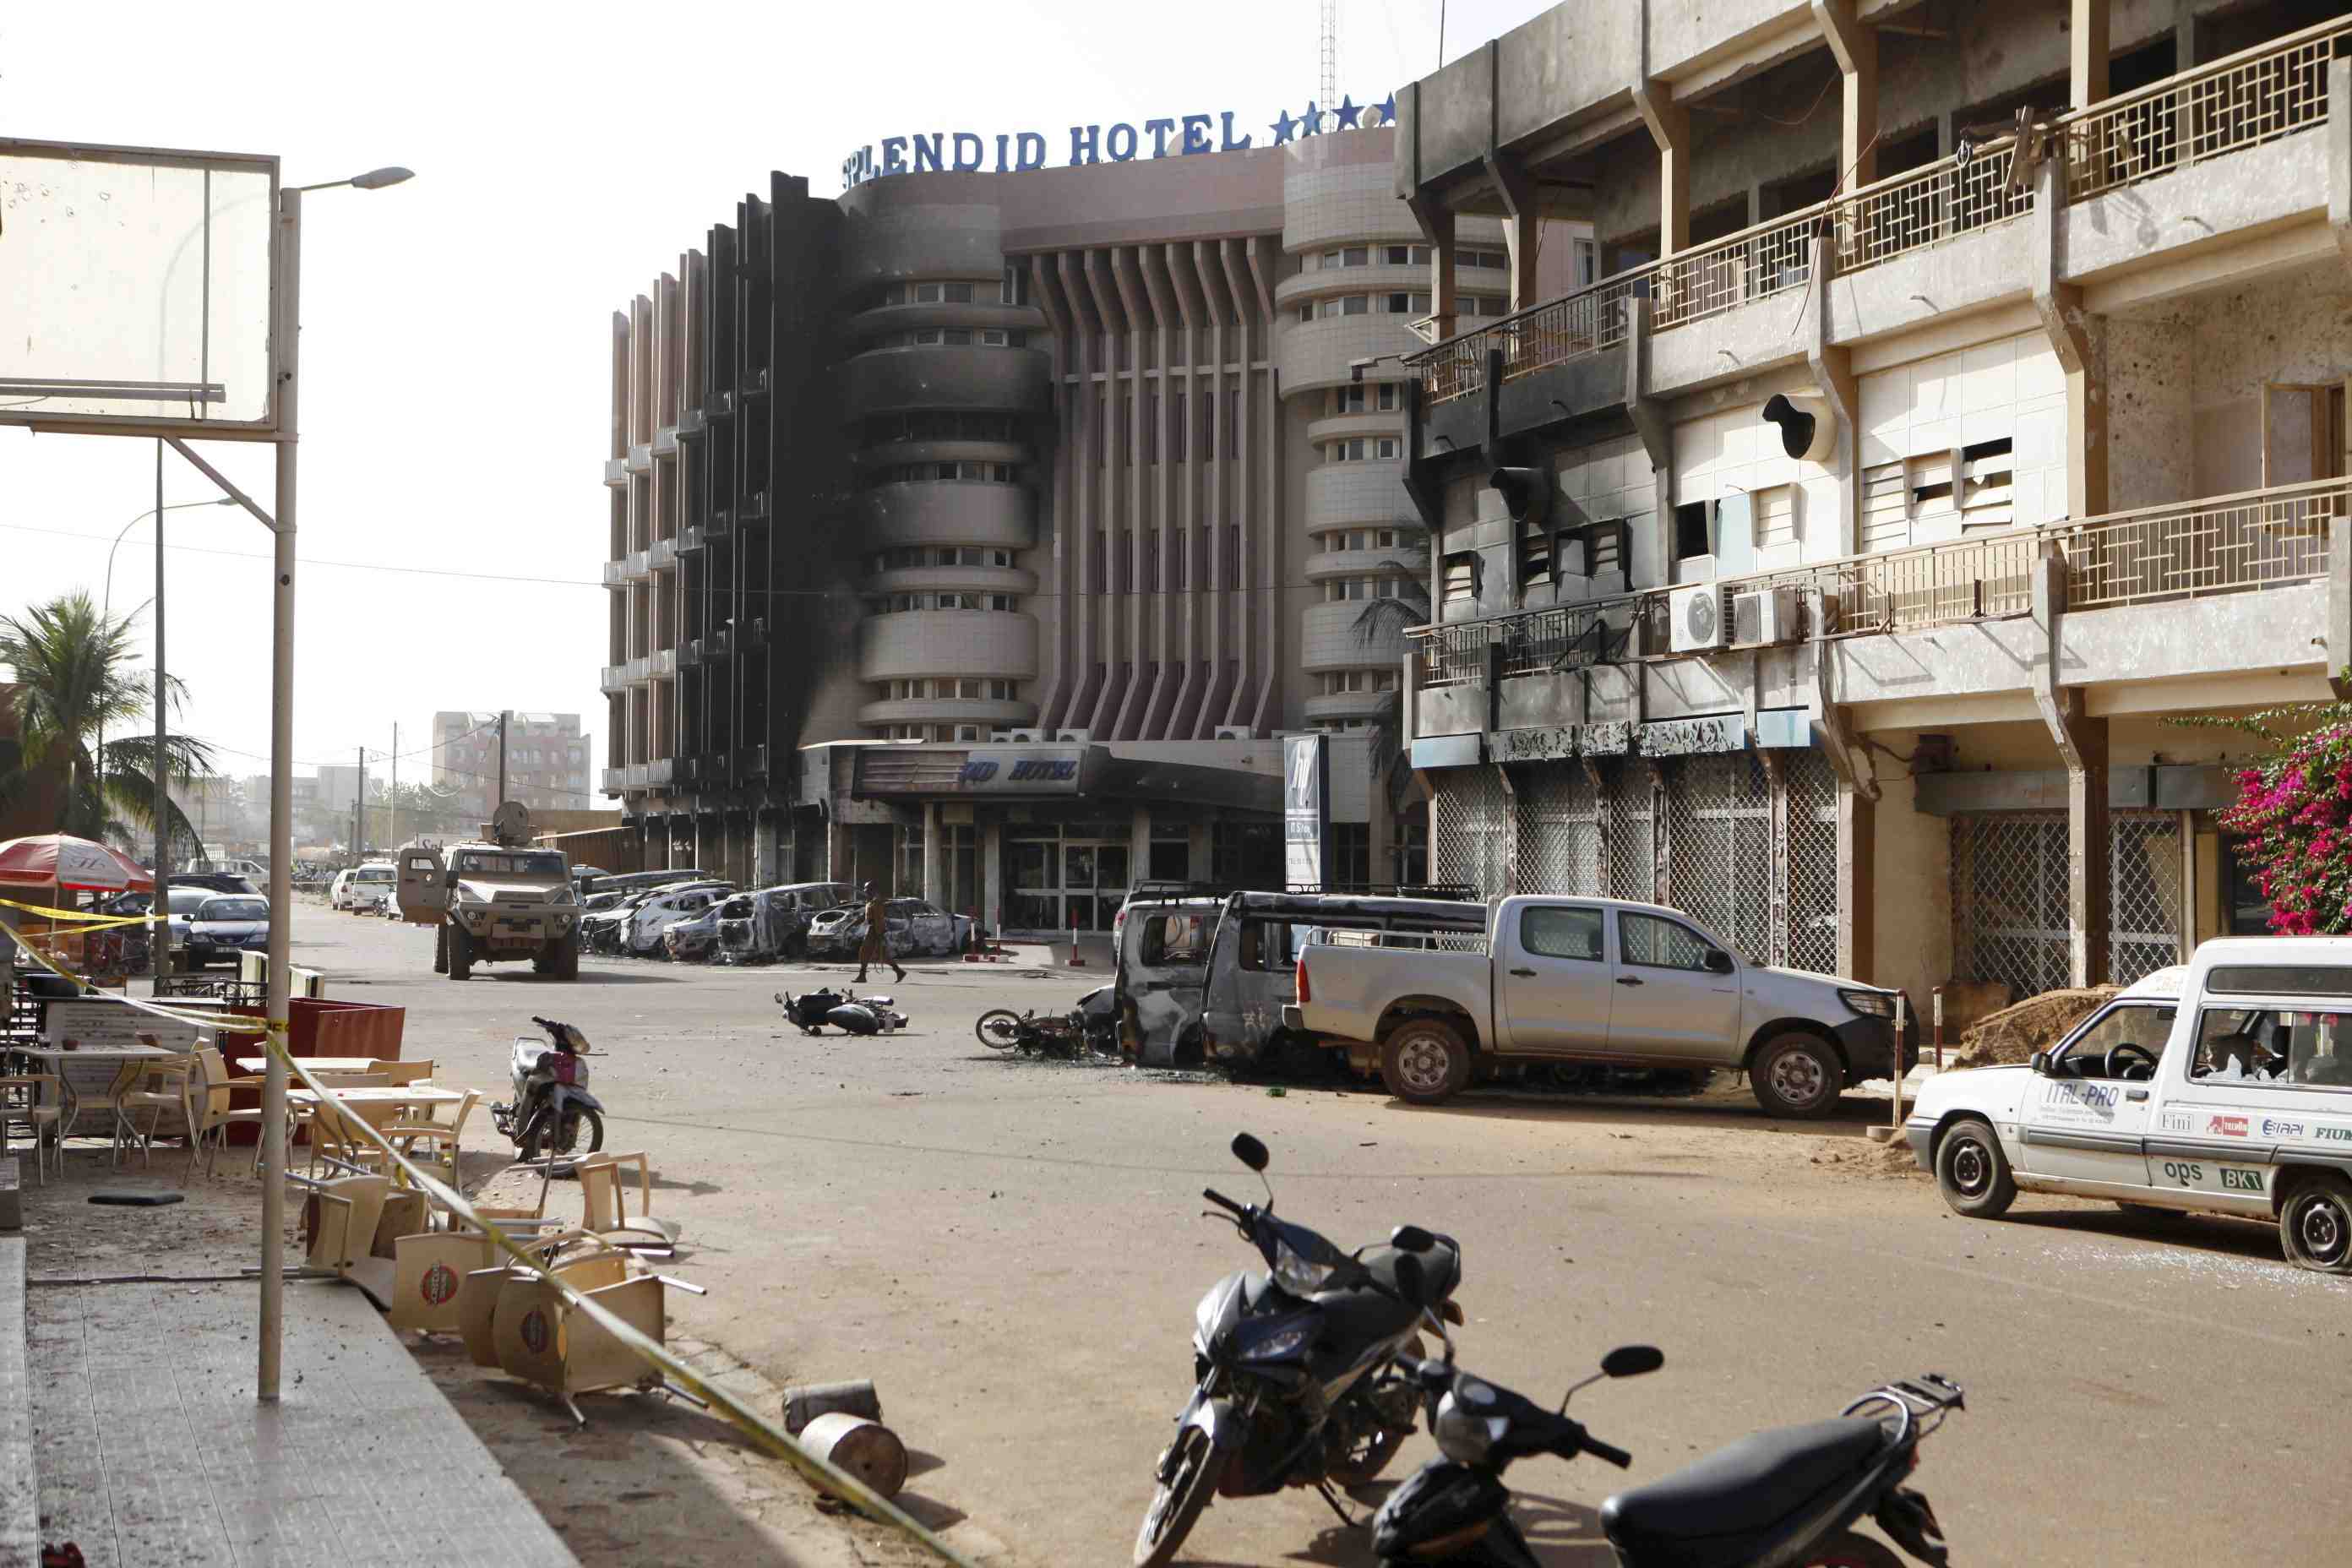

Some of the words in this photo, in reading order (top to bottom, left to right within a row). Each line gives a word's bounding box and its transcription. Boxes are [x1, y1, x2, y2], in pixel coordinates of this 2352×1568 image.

[842, 132, 1047, 190] SPLENDID
[1070, 112, 1252, 166] HOTEL
[1008, 760, 1077, 781] HOTEL
[2046, 1081, 2120, 1107] ITAL-PRO
[2163, 1113, 2191, 1130] Fini
[2225, 1171, 2263, 1190] BKT
